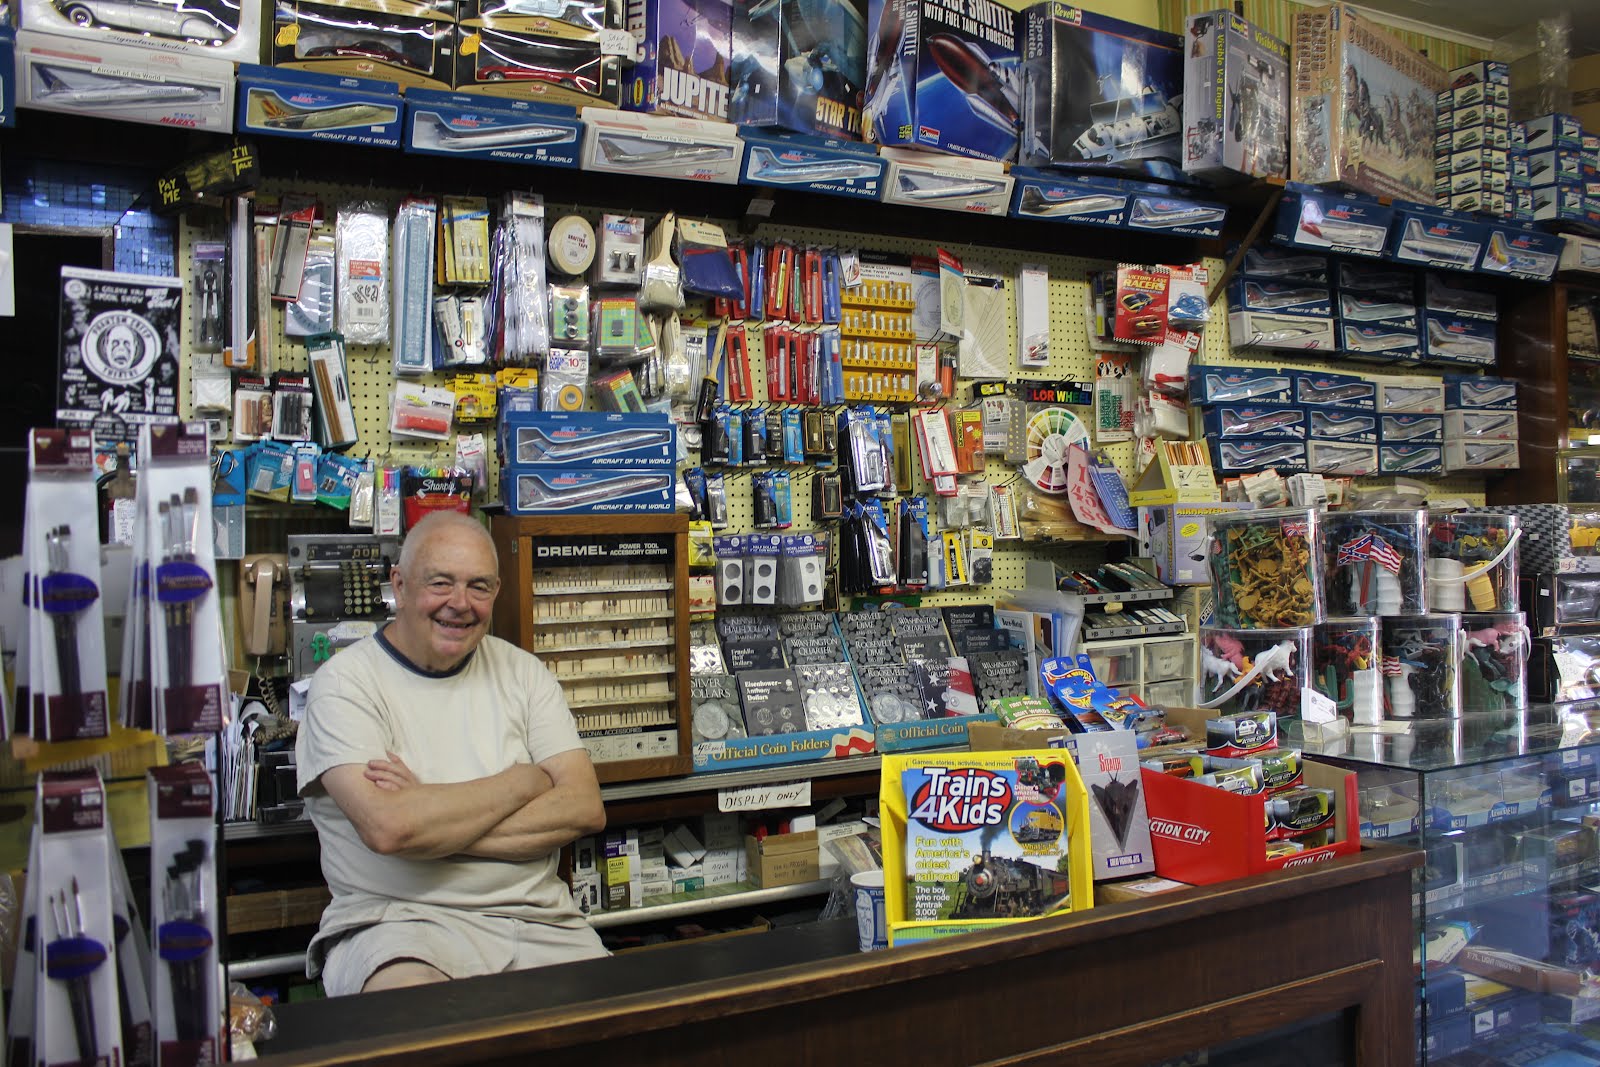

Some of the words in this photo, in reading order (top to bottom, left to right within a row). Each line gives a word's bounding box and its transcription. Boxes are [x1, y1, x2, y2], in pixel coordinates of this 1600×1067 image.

[1055, 4, 1075, 20] Revell
[924, 3, 948, 22] WITH
[945, 10, 961, 29] FUEL
[962, 17, 979, 36] TANK
[979, 24, 985, 37] &
[985, 27, 1015, 51] BOOSTERS
[1230, 17, 1245, 36] Revell
[904, 10, 918, 57] SHUTTLE
[1028, 12, 1036, 59] Shuttle
[1036, 16, 1044, 57] Space
[1254, 30, 1278, 54] Visible
[1216, 34, 1224, 66] Visible
[97, 67, 121, 76] Aircraft
[142, 72, 161, 81] World
[1216, 68, 1224, 85] V-8
[1215, 87, 1223, 119] Engine
[815, 96, 845, 129] STAR
[160, 116, 197, 127] MARKS
[312, 131, 346, 141] AIRCRAFT
[347, 134, 358, 142] OF
[358, 136, 372, 144] THE
[373, 137, 398, 146] WORLD
[490, 150, 522, 159] AIRCRAFT
[535, 154, 548, 162] THE
[548, 155, 573, 164] WORLD
[158, 178, 177, 194] PAY
[809, 182, 836, 191] AIRCRAFT
[856, 188, 877, 196] WORLD
[163, 189, 181, 206] ME
[1067, 215, 1089, 223] AIRCRAFT
[1171, 226, 1191, 234] AIRCRAFT
[1128, 274, 1152, 282] VICTORY
[1122, 279, 1167, 291] RACERS
[568, 358, 579, 367] 10
[456, 373, 474, 381] Scotch
[1056, 390, 1090, 405] WHEEL
[537, 545, 608, 558] DREMEL
[609, 548, 645, 556] ACCESSORY
[782, 614, 829, 623] WASHINGTON
[847, 612, 882, 621] ROOSEVELT
[897, 616, 939, 625] WASHINGTON
[950, 612, 976, 620] Statehood
[787, 622, 822, 632] QUARTER
[856, 621, 874, 629] DIME
[902, 623, 935, 632] QUARTERS
[790, 638, 838, 648] WASHINGTON
[966, 634, 991, 642] Statehood
[855, 640, 892, 649] ROOSEVELT
[798, 646, 832, 656] QUARTER
[866, 648, 885, 657] DIME
[732, 659, 753, 667] Dollars
[981, 660, 1018, 670] WASHINGTON
[867, 668, 906, 678] ROOSEVELT
[986, 667, 1016, 677] QUARTERS
[691, 678, 722, 688] SILVER
[880, 676, 899, 686] DIME
[746, 687, 771, 696] Anthony
[746, 693, 769, 701] Dollars
[603, 726, 643, 737] ACCESSORIES
[900, 725, 939, 740] Official
[940, 723, 965, 735] Coin
[712, 746, 758, 761] Official
[761, 742, 787, 755] Coin
[791, 738, 830, 753] Folders
[935, 759, 956, 767] stories,
[922, 767, 1006, 797] Trains
[724, 794, 771, 809] DISPLAY
[776, 788, 804, 800] ONLY
[910, 796, 1003, 825] 4Kids
[1149, 820, 1183, 837] CTION
[1184, 825, 1212, 843] CITY
[915, 837, 937, 847] Fun
[939, 837, 963, 847] with
[915, 848, 970, 859] America's
[1316, 850, 1336, 863] CITY
[915, 860, 949, 870] oldest
[915, 871, 960, 882] railroad
[915, 886, 932, 894] The
[932, 886, 946, 896] boy
[915, 893, 932, 901] who
[933, 893, 950, 901] rode
[915, 901, 943, 909] Amtrak
[915, 909, 937, 917] 3,000
